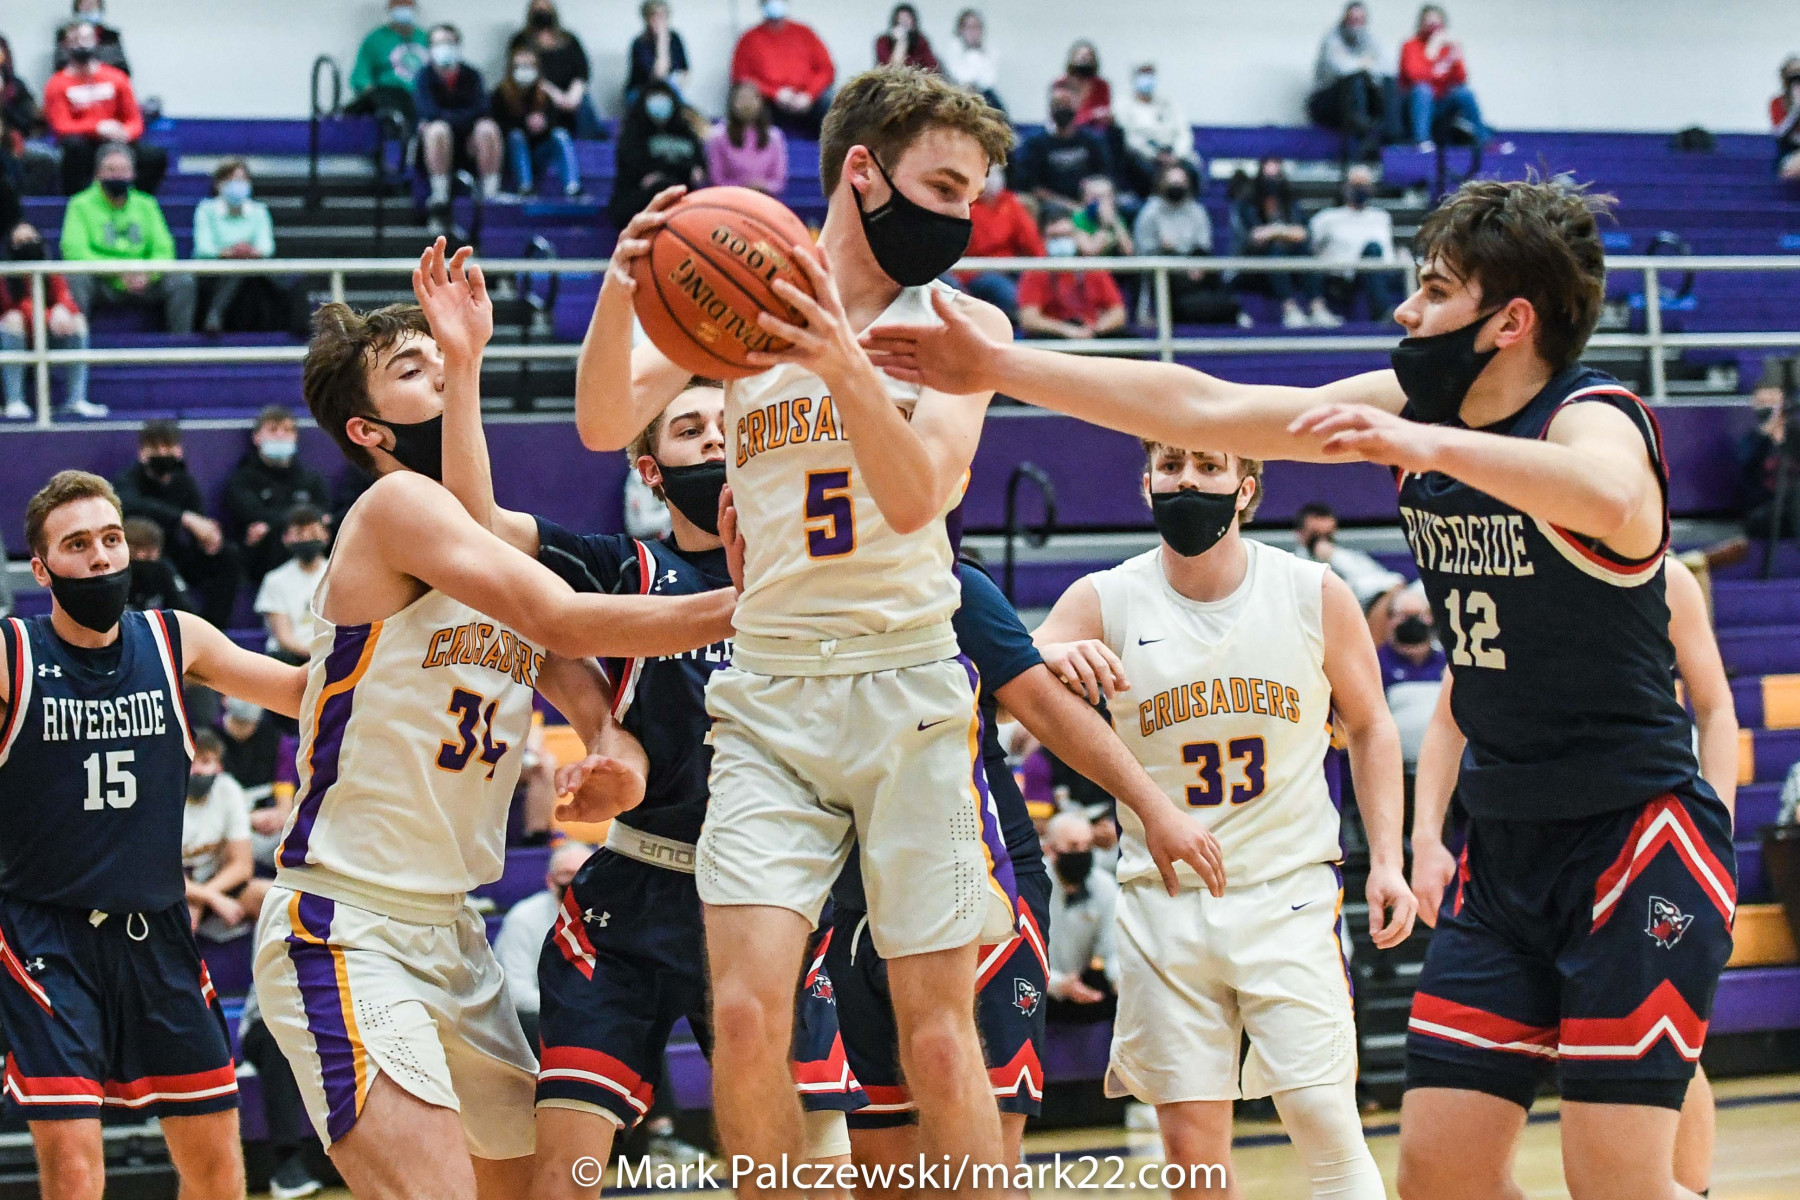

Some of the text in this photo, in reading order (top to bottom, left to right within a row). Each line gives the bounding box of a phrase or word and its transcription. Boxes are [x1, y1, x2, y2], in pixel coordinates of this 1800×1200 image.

[736, 396, 850, 468] CRUSA
[803, 467, 857, 561] 5
[1399, 506, 1535, 578] RIVERSIDE
[1444, 588, 1507, 671] 12
[42, 689, 166, 742] RIVERSIDE
[434, 686, 510, 782] 34
[1139, 677, 1301, 737] CRUSADERS
[83, 749, 137, 811] 15
[1180, 734, 1268, 808] 33
[638, 840, 694, 865] OUR
